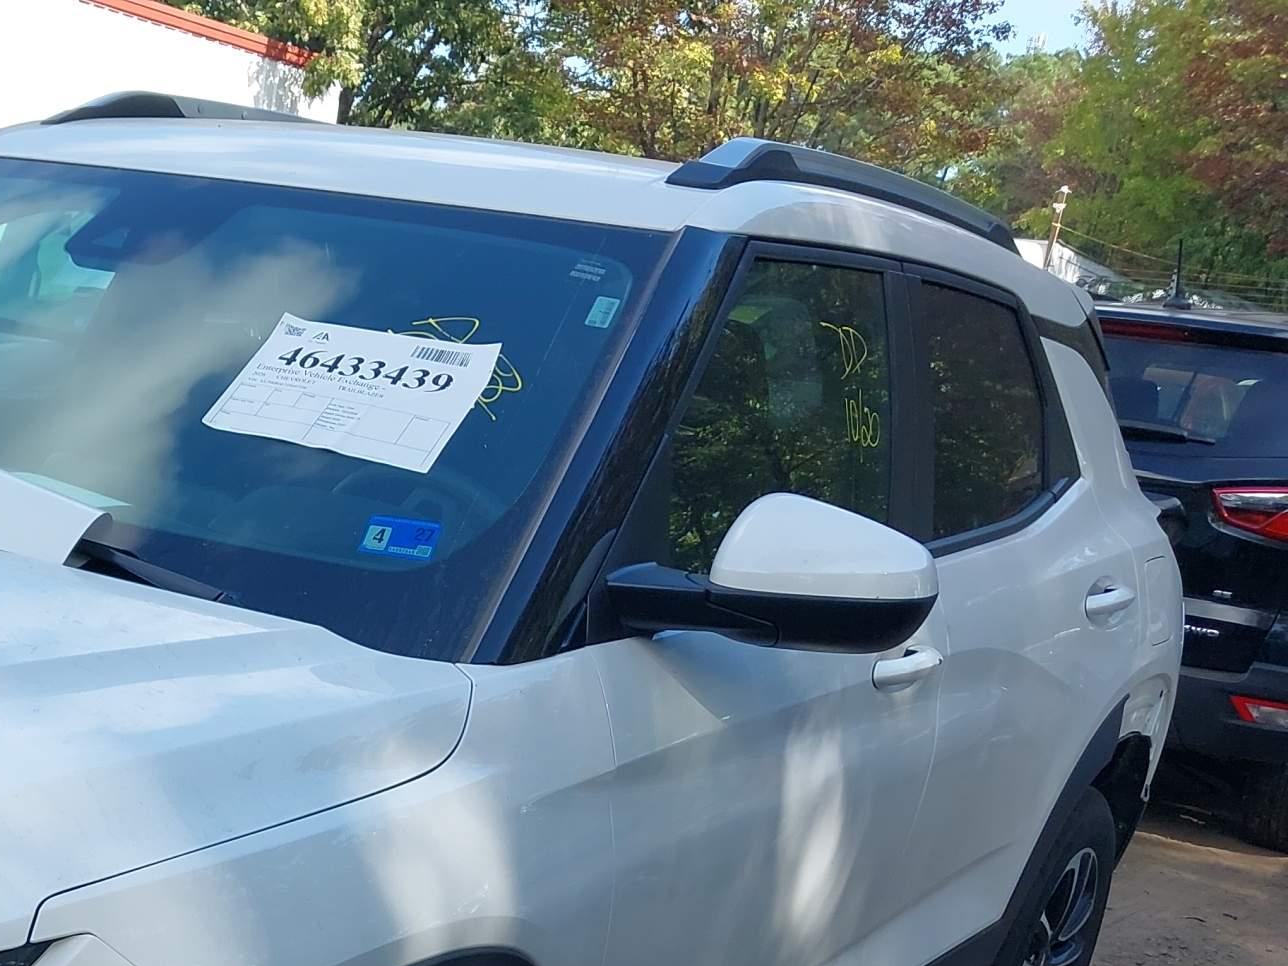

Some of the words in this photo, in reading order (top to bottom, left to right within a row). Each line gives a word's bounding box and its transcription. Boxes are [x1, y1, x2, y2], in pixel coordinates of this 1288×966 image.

[256, 363, 301, 376] Enterprise
[304, 369, 336, 382] Vehicle
[337, 377, 380, 391] Exchange
[278, 346, 454, 393] 46433439
[372, 528, 387, 543] 4
